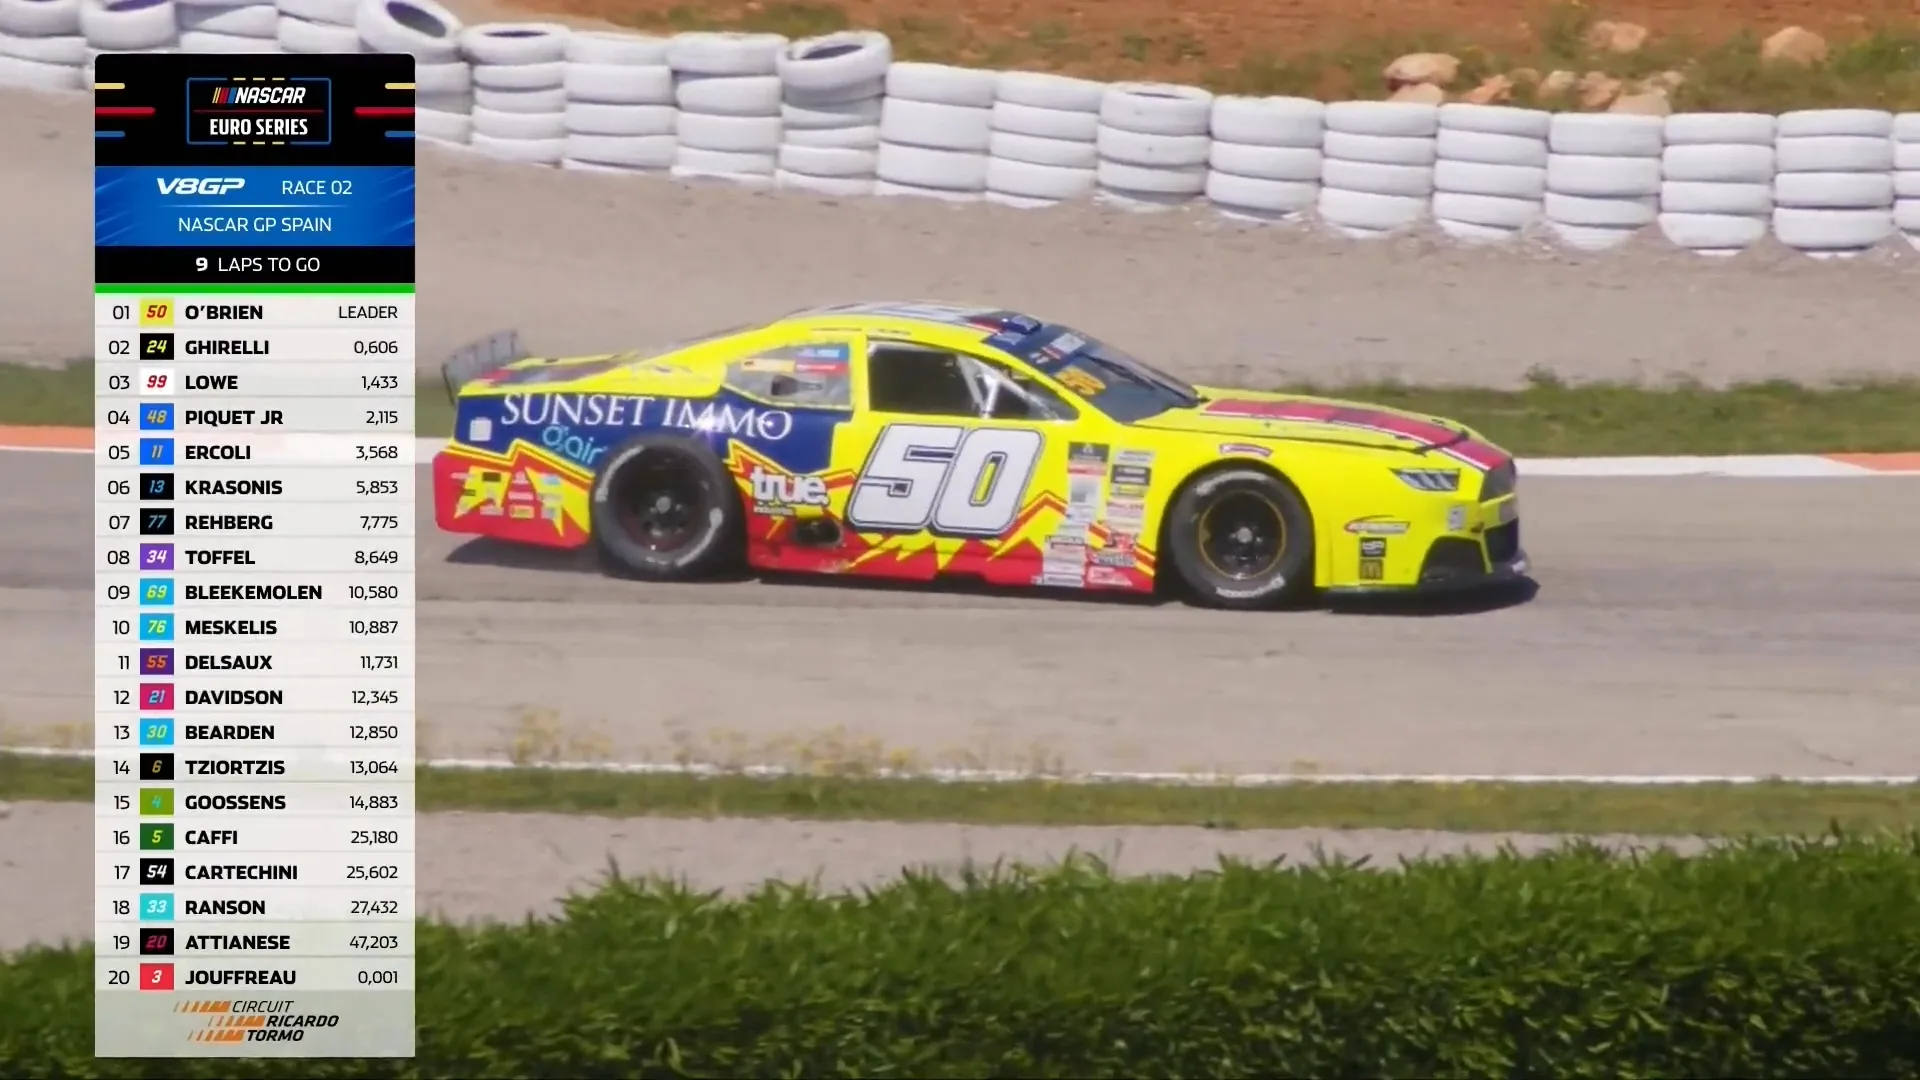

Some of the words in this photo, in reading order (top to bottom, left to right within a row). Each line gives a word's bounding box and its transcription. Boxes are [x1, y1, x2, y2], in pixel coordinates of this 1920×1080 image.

[501, 392, 655, 426] SUNSET
[661, 398, 793, 441] IMMO
[848, 423, 1046, 537] 50
